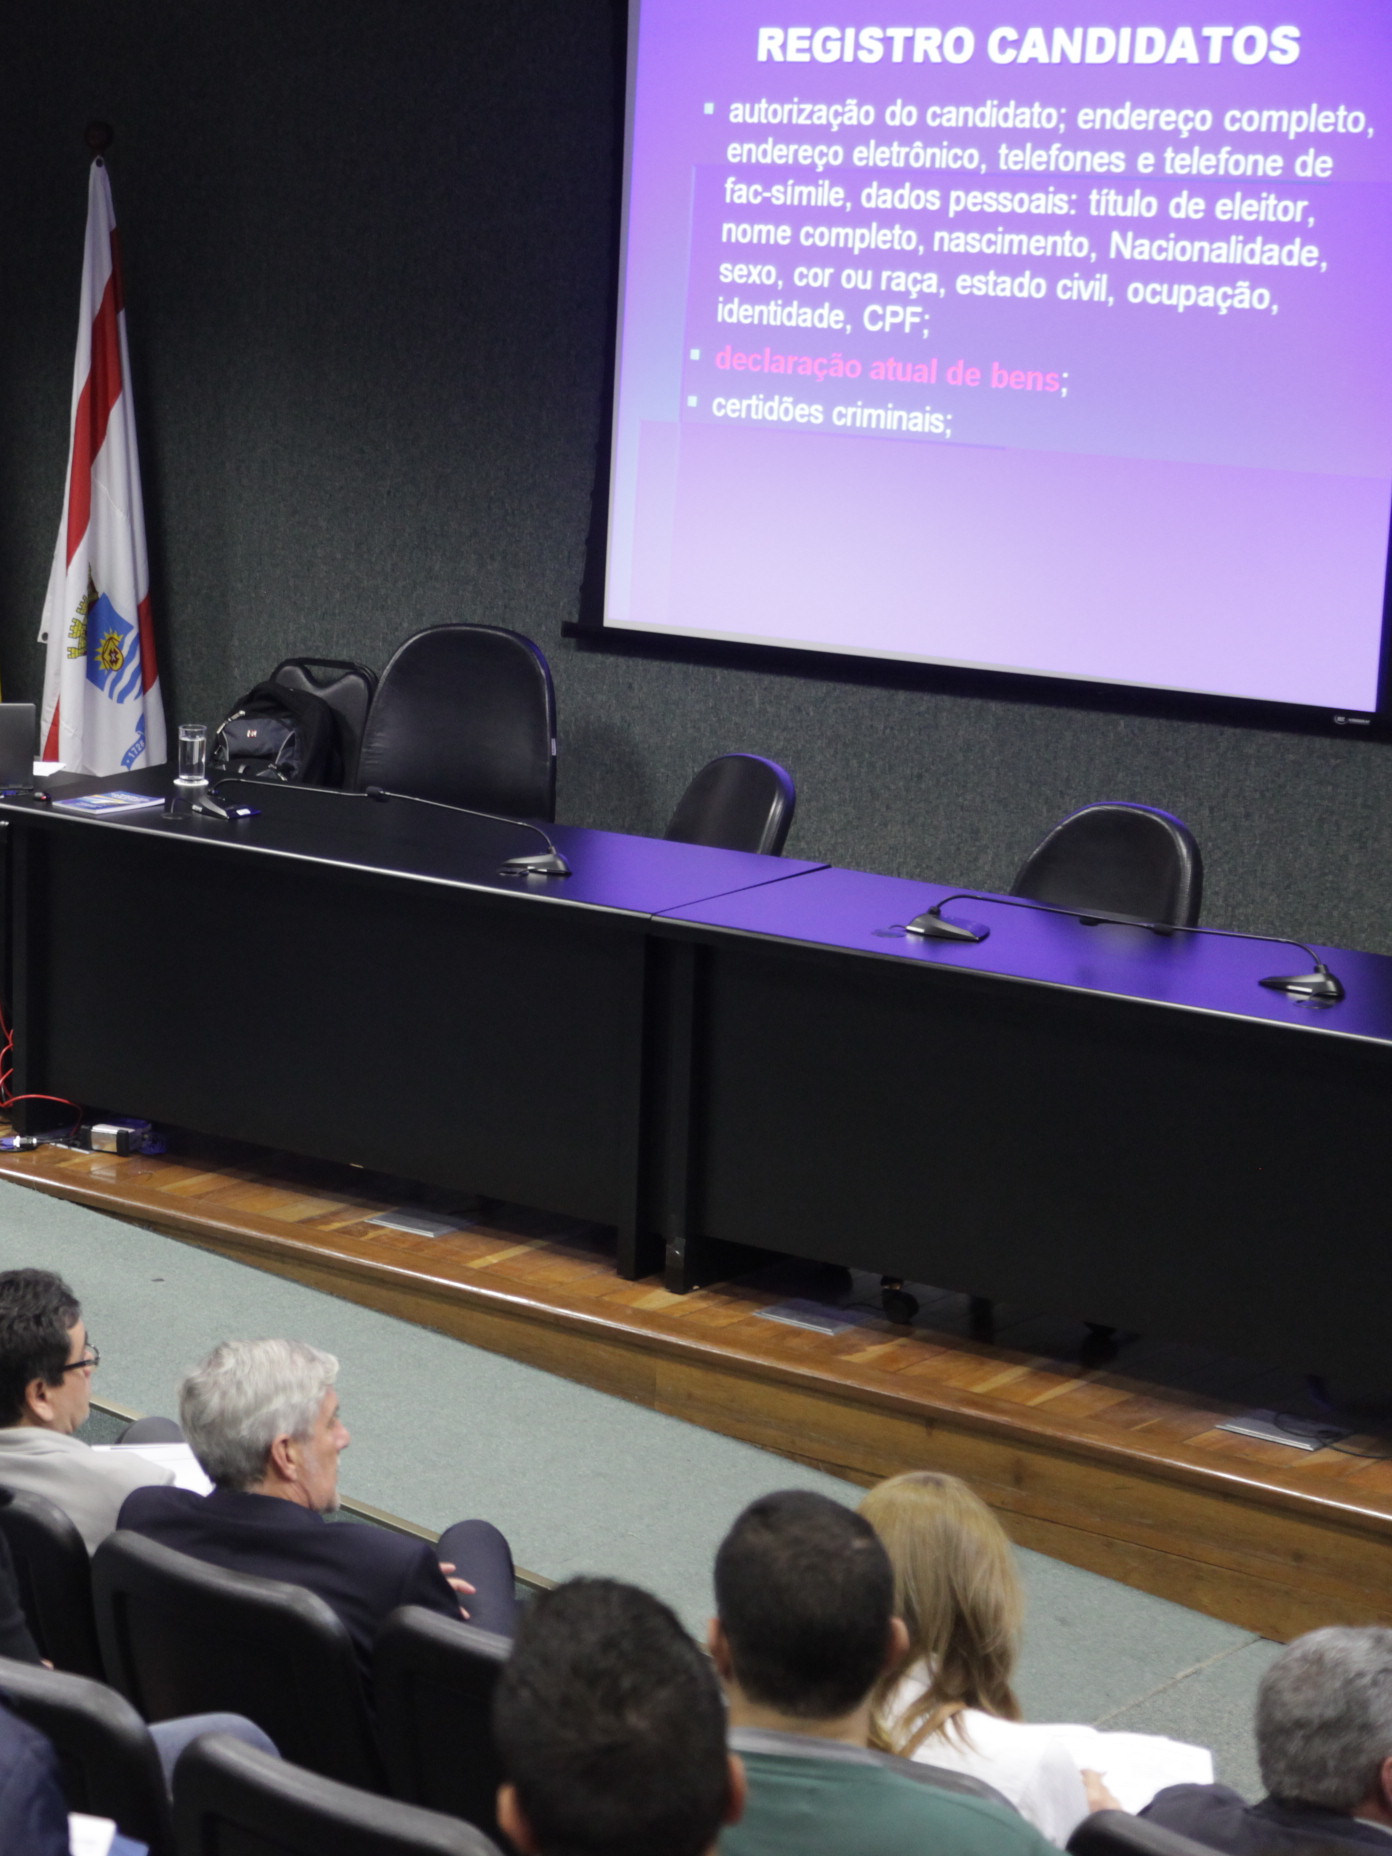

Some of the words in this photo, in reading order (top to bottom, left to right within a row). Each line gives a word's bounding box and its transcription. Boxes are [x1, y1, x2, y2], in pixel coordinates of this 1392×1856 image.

[757, 26, 975, 64] REGISTRO
[987, 25, 1301, 65] CANDIDATOS
[729, 98, 874, 131] autorização
[885, 98, 917, 127] do
[926, 99, 1066, 134] candidato;
[1077, 101, 1213, 138] endereço
[1224, 103, 1374, 140] completo,
[726, 137, 843, 172] endereço
[852, 139, 986, 174] eletrônico,
[998, 143, 1126, 173] telefones
[1137, 151, 1155, 173] e
[1164, 146, 1284, 176] telefone
[1294, 148, 1333, 178] de
[724, 177, 852, 212] fac-símile,
[861, 181, 941, 211] dados
[948, 187, 1077, 218] pessoais:
[1089, 188, 1158, 218] título
[1169, 190, 1205, 219] de
[1215, 192, 1314, 228] eleitor,
[722, 222, 792, 245] nome
[800, 222, 924, 255] completo,
[933, 227, 1097, 262] nascimento,
[1109, 230, 1327, 273] Nacionalidade,
[719, 263, 784, 289] sexo,
[794, 266, 834, 287] cor
[841, 268, 872, 290] ou
[881, 270, 945, 299] raça,
[956, 270, 1046, 298] estado
[1057, 273, 1114, 307] civil,
[1127, 280, 1279, 315] ocupação,
[717, 297, 851, 334] identidade,
[863, 304, 930, 339] CPF;
[715, 345, 862, 382] declaração
[869, 357, 938, 384] atual
[946, 360, 981, 386] de
[991, 362, 1068, 397] bens;
[712, 394, 824, 425] certidões
[832, 401, 953, 438] criminais;
